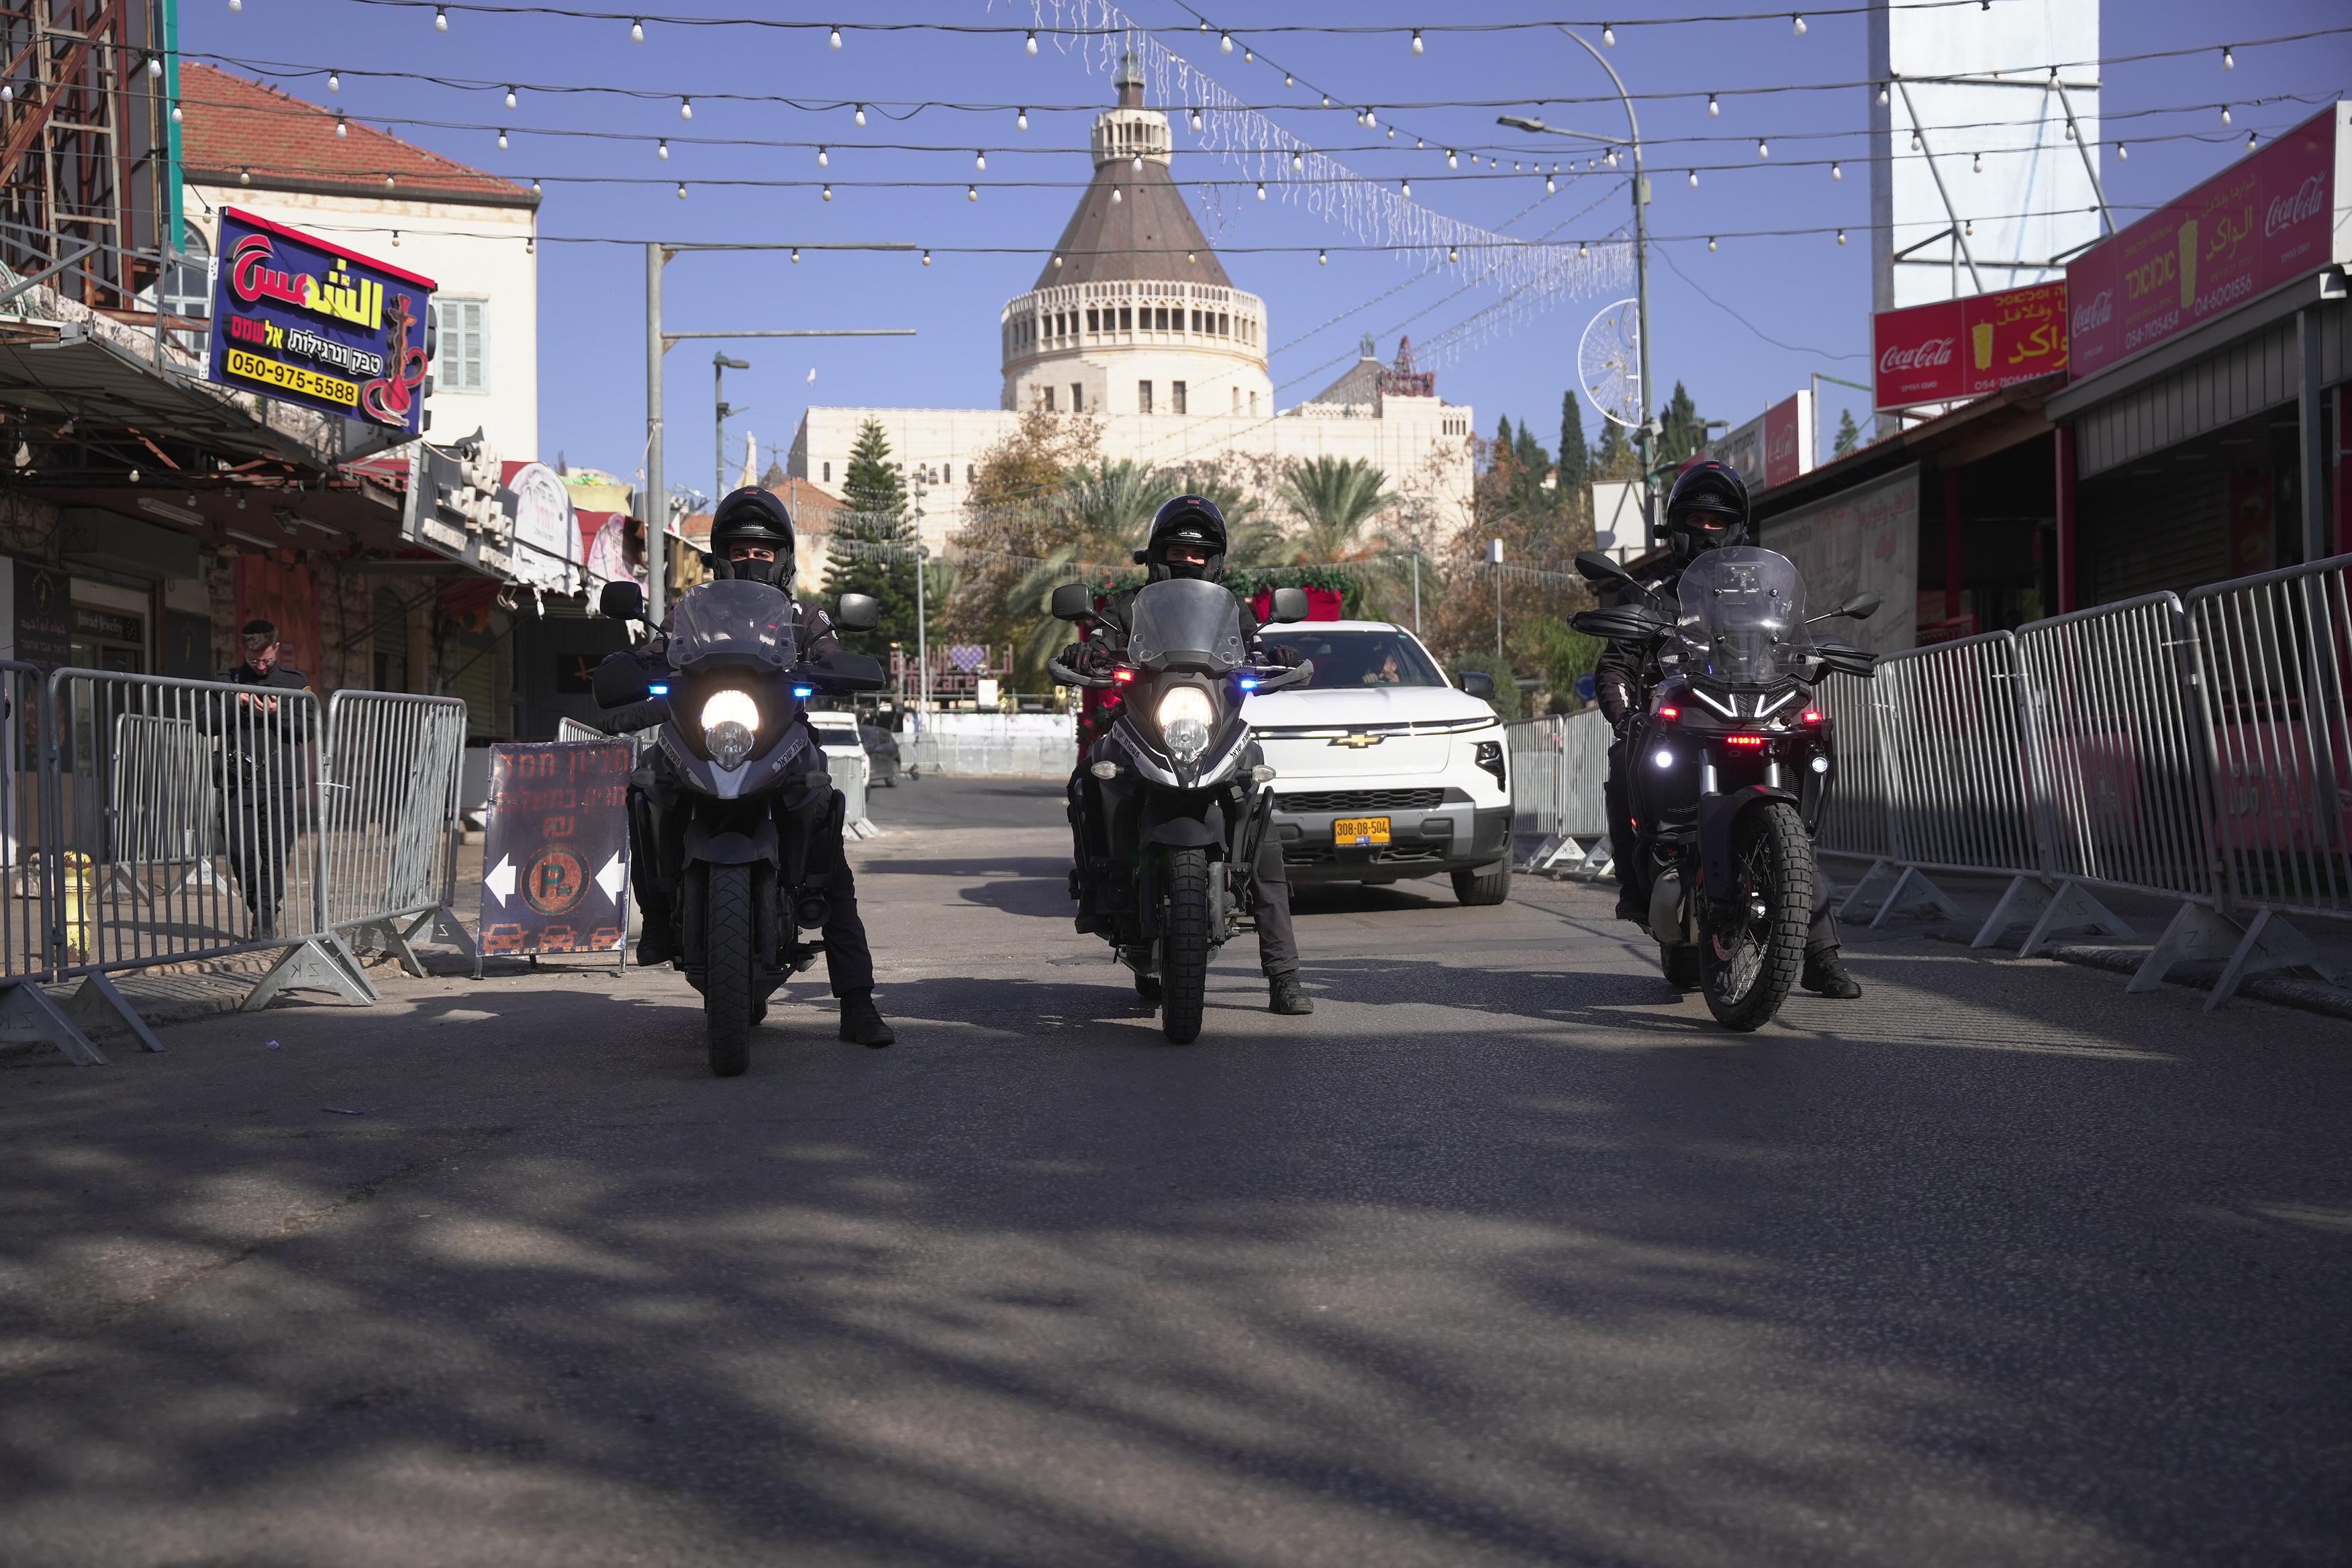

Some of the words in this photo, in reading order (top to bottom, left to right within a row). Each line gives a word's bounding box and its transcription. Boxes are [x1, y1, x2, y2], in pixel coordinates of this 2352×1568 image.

[234, 234, 383, 330] الشمس
[2194, 273, 2253, 316] 04-6001556
[2126, 308, 2179, 350] 054-7105454
[288, 328, 348, 370] ונרגילות
[348, 348, 384, 376] טבק
[1879, 336, 1956, 374] Coca-Cola
[232, 353, 355, 404] 050-975-5588
[77, 611, 97, 628] Jawad
[99, 615, 123, 638] Jewelry
[777, 750, 793, 768] ישראל
[1124, 738, 1140, 758] משטרת
[1229, 743, 1242, 760] ישראל
[539, 863, 566, 898] P
